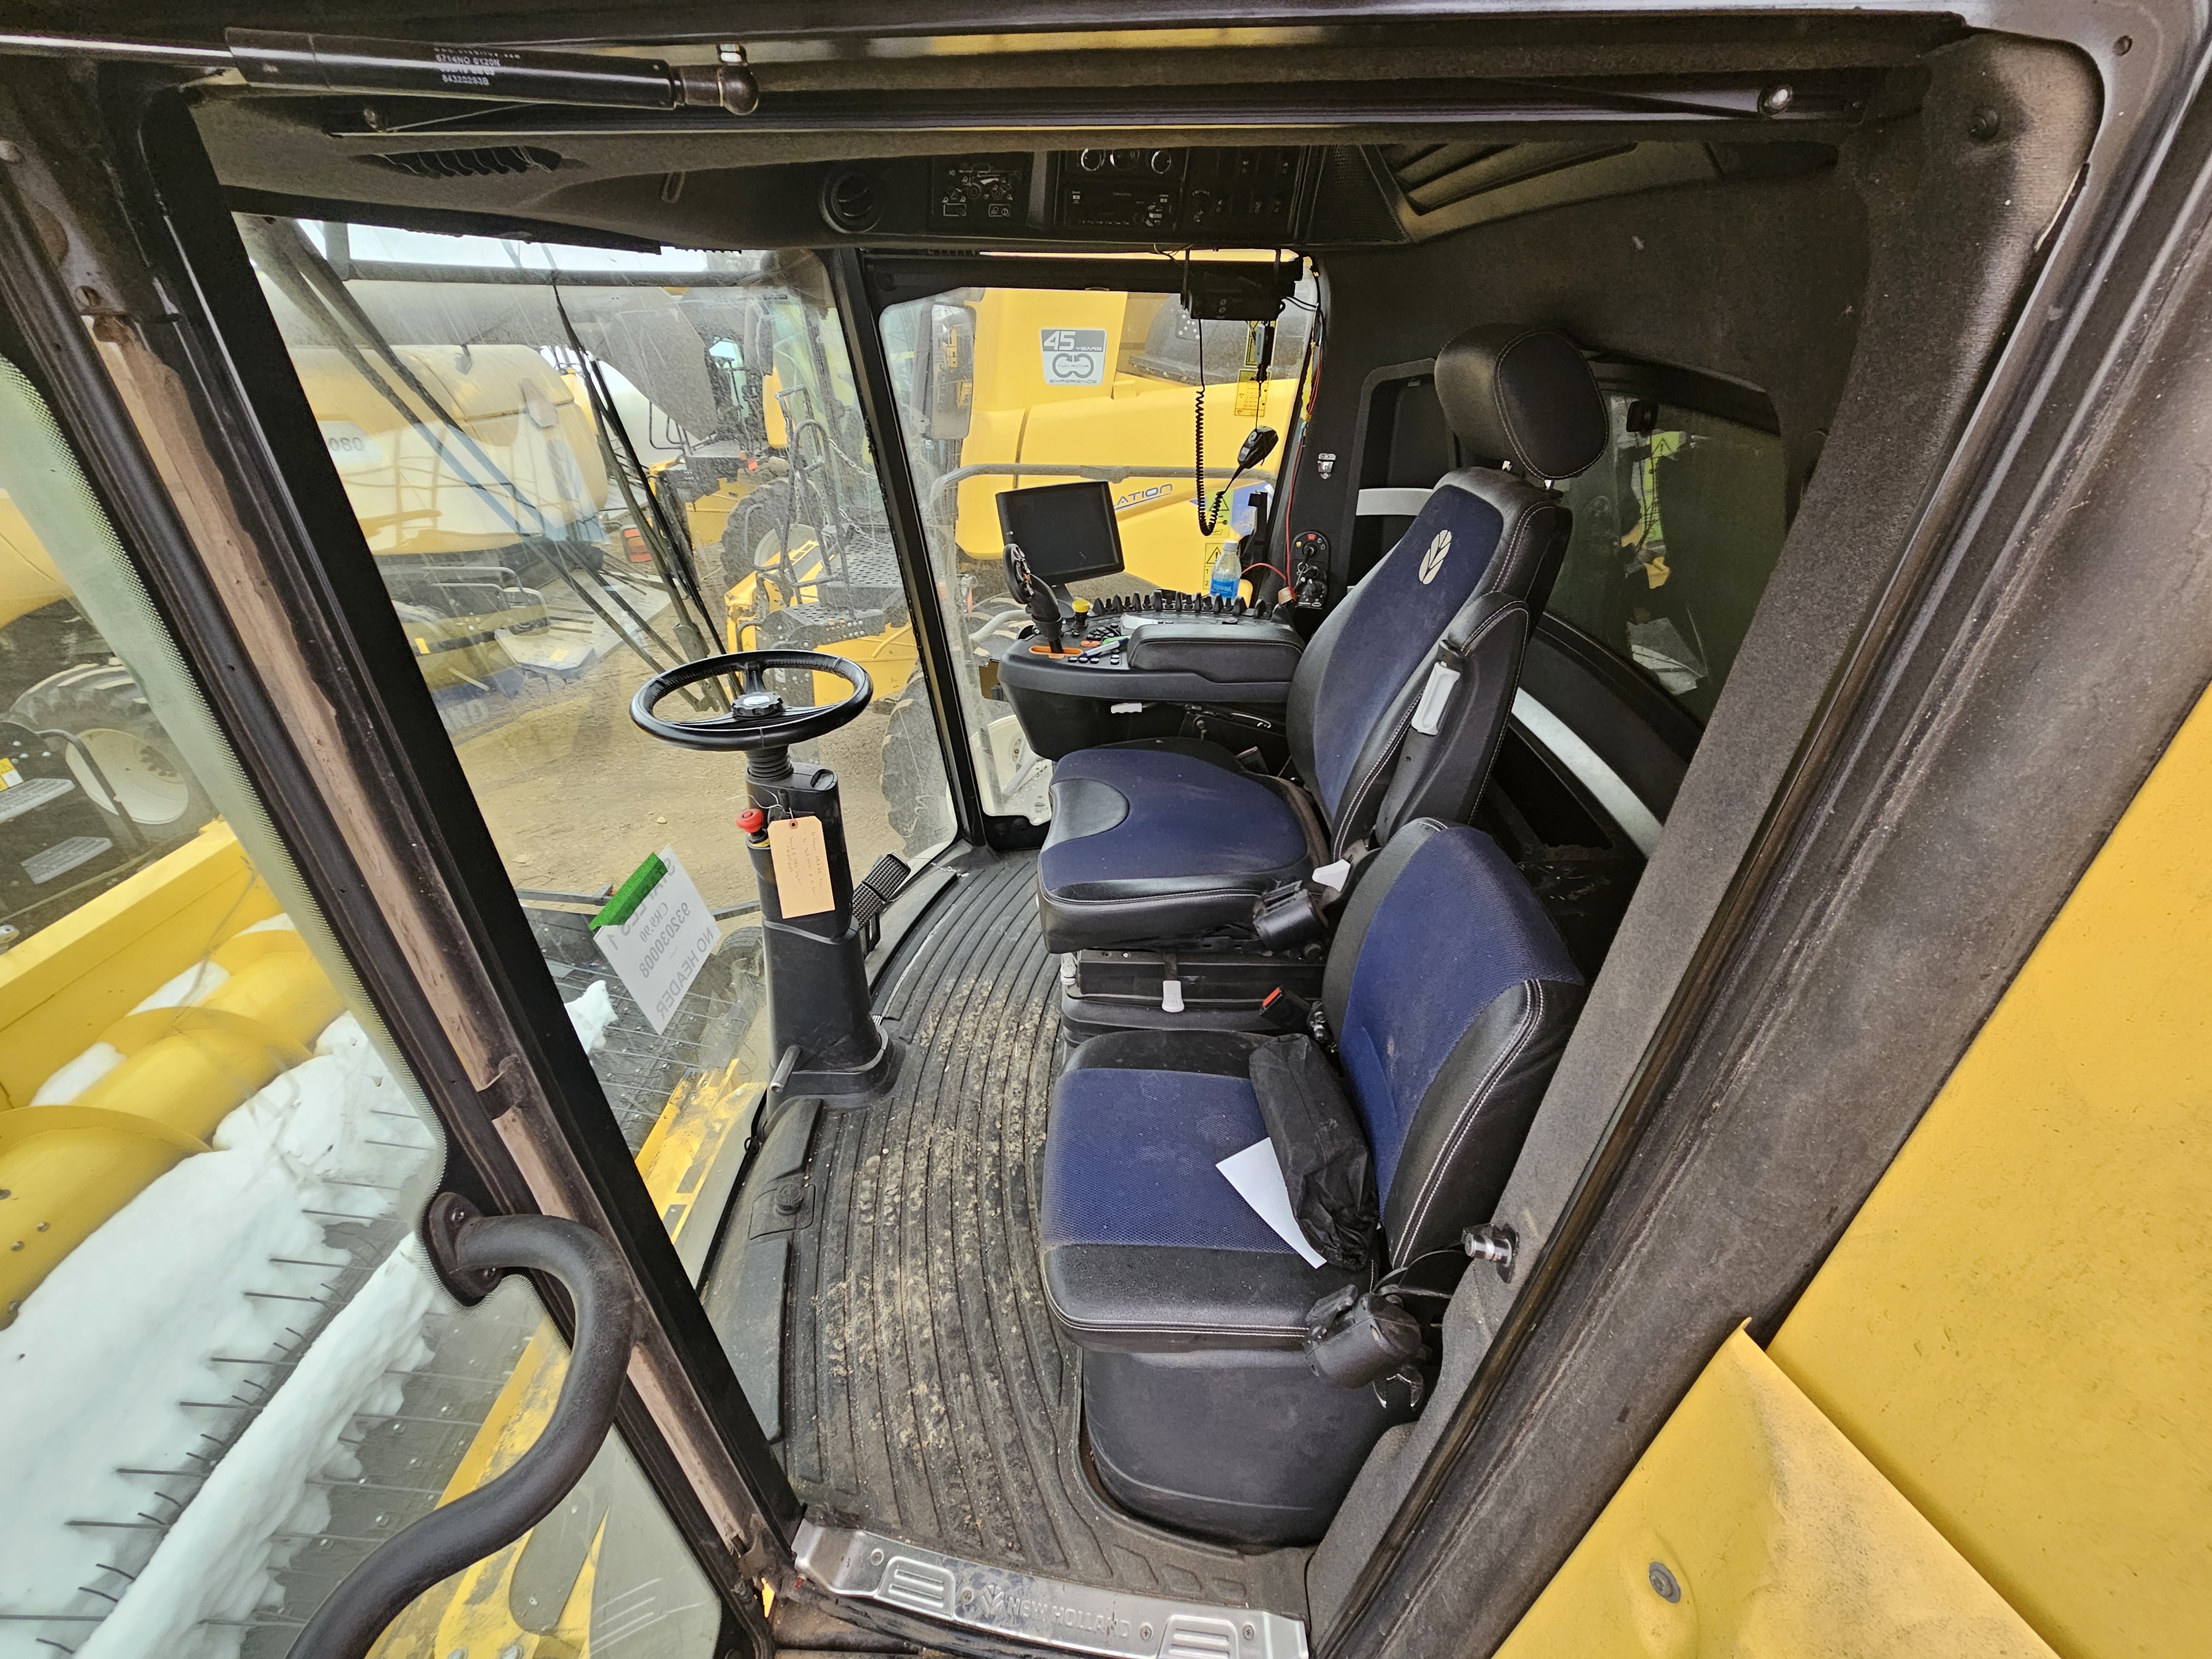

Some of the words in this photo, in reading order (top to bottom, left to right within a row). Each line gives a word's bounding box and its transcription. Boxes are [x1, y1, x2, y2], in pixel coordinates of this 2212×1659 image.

[1044, 330, 1076, 351] 45
[1007, 1596, 1048, 1621] NEW
[1052, 1605, 1132, 1638] HOLLAND
